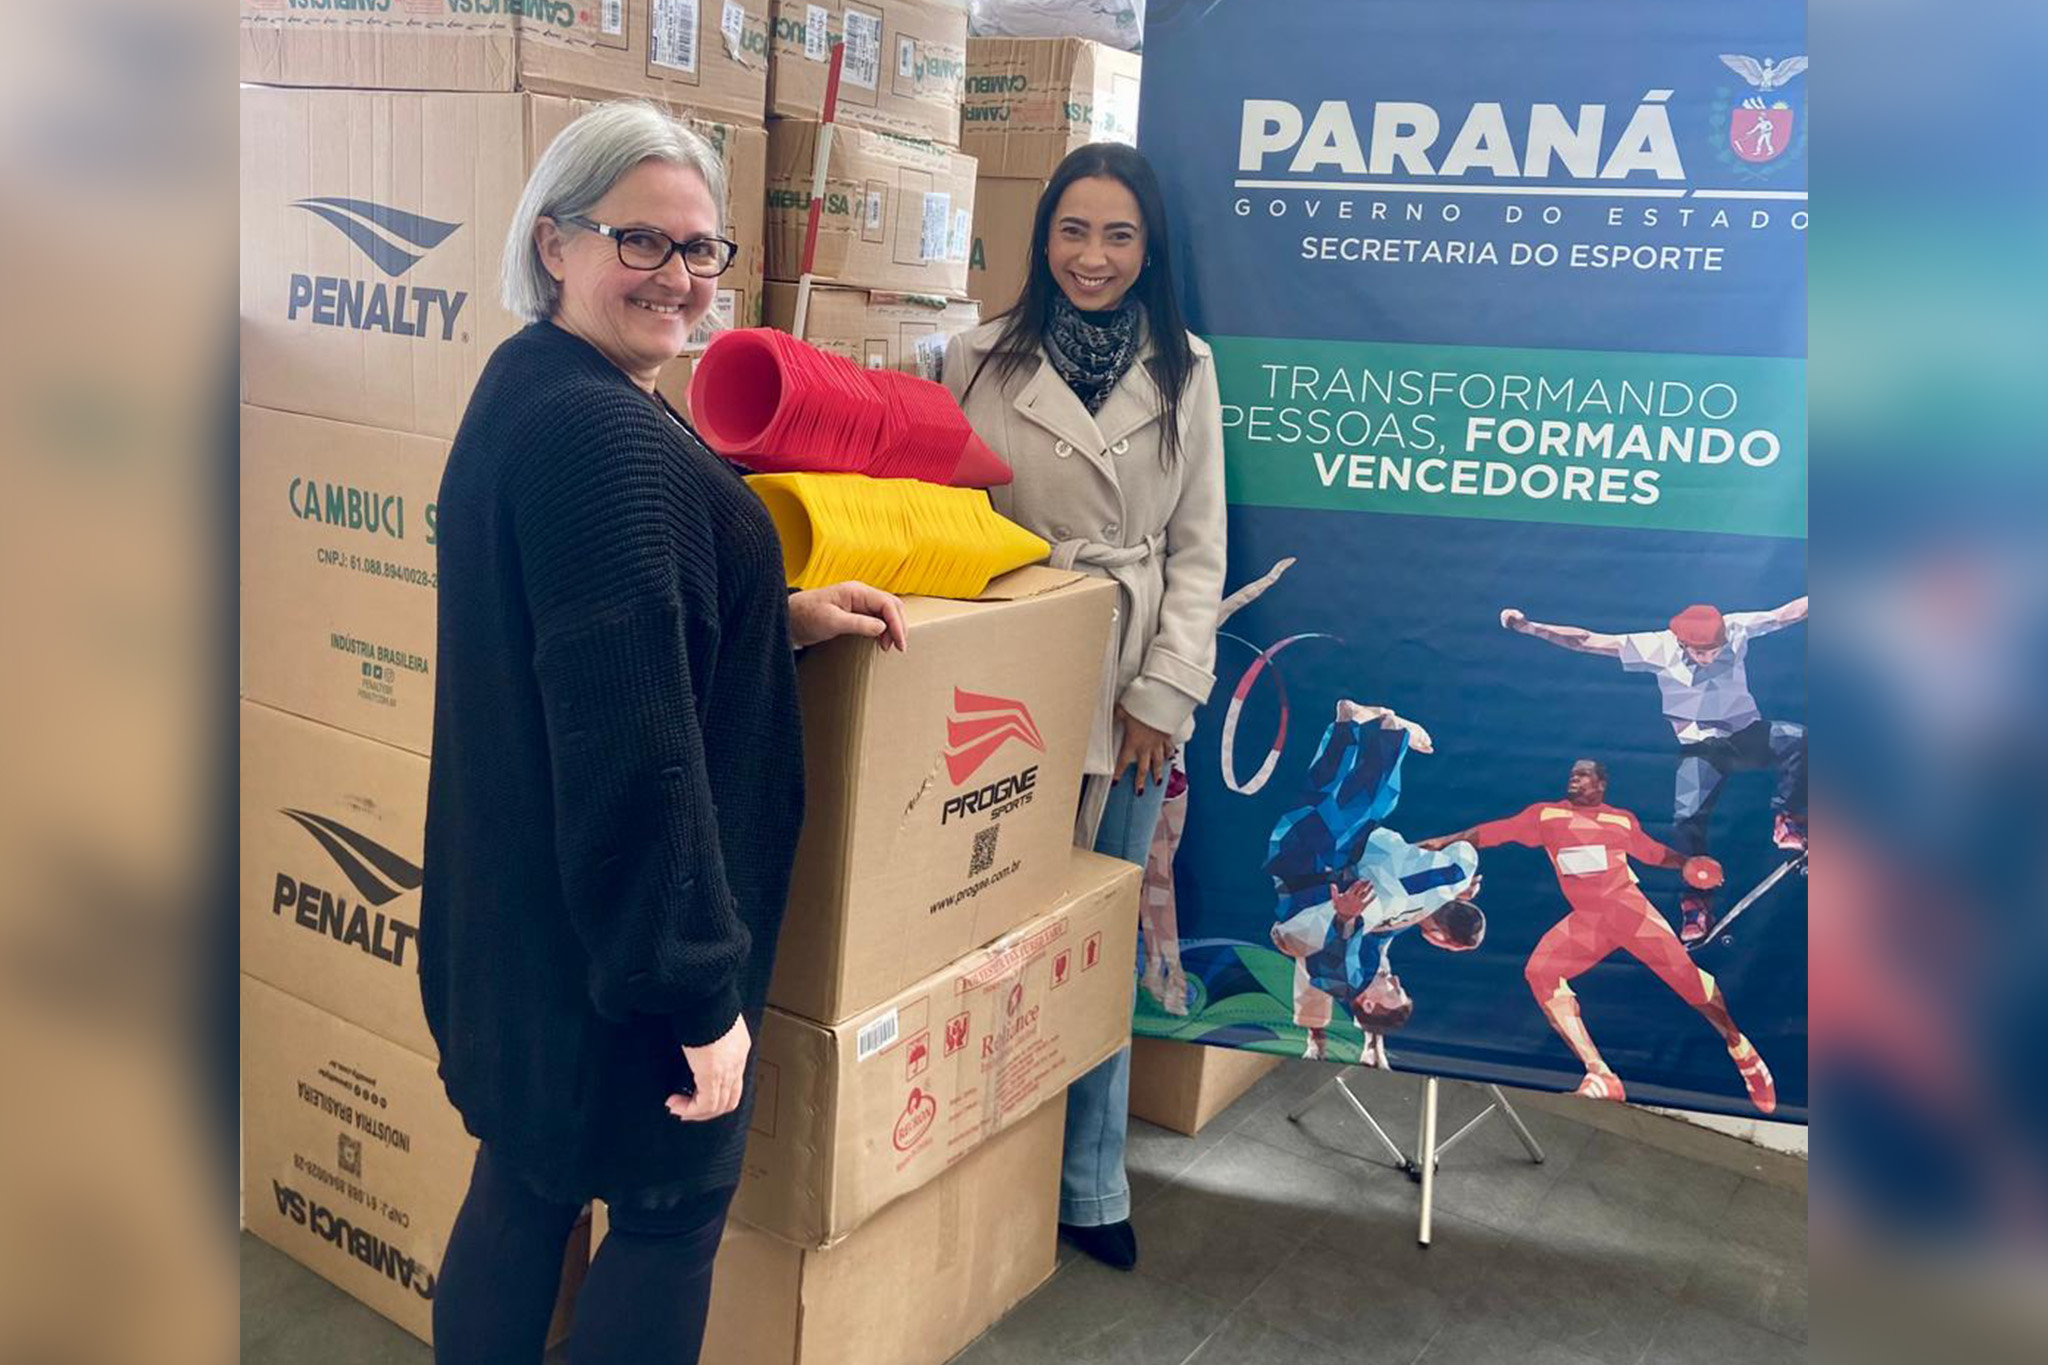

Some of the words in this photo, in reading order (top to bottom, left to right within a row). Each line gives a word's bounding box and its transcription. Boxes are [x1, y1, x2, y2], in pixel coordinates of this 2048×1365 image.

[1238, 89, 1686, 181] PARANÁ
[1234, 199, 1461, 222] GOVERNO
[1505, 205, 1562, 225] DO
[1607, 208, 1808, 231] ESTADO
[1300, 236, 1499, 266] SECRETARIA
[1510, 244, 1560, 267] DO
[1570, 244, 1725, 271] ESPORTE
[287, 272, 468, 342] PENALTY
[1262, 364, 1738, 420] TRANSFORMANDO
[1220, 405, 1447, 455] PESSOAS,
[1465, 417, 1781, 468] FORMANDO
[1313, 452, 1661, 506] VENCEDORES
[289, 477, 404, 540] CAMBUCI
[317, 548, 348, 568] CNPJ:
[330, 632, 375, 660] INDÚSTRIA
[377, 645, 429, 675] BRASILEIRA
[941, 765, 1039, 826] PROGNE
[990, 791, 1034, 821] SPORTS
[929, 859, 1022, 915] www.progne.com.br
[272, 872, 421, 975] PENALT
[297, 1079, 353, 1125] BRASILEIRA
[354, 1109, 410, 1153] INDÚSTRIA
[272, 1177, 307, 1226] SA
[310, 1200, 437, 1300] CAMBUCI
